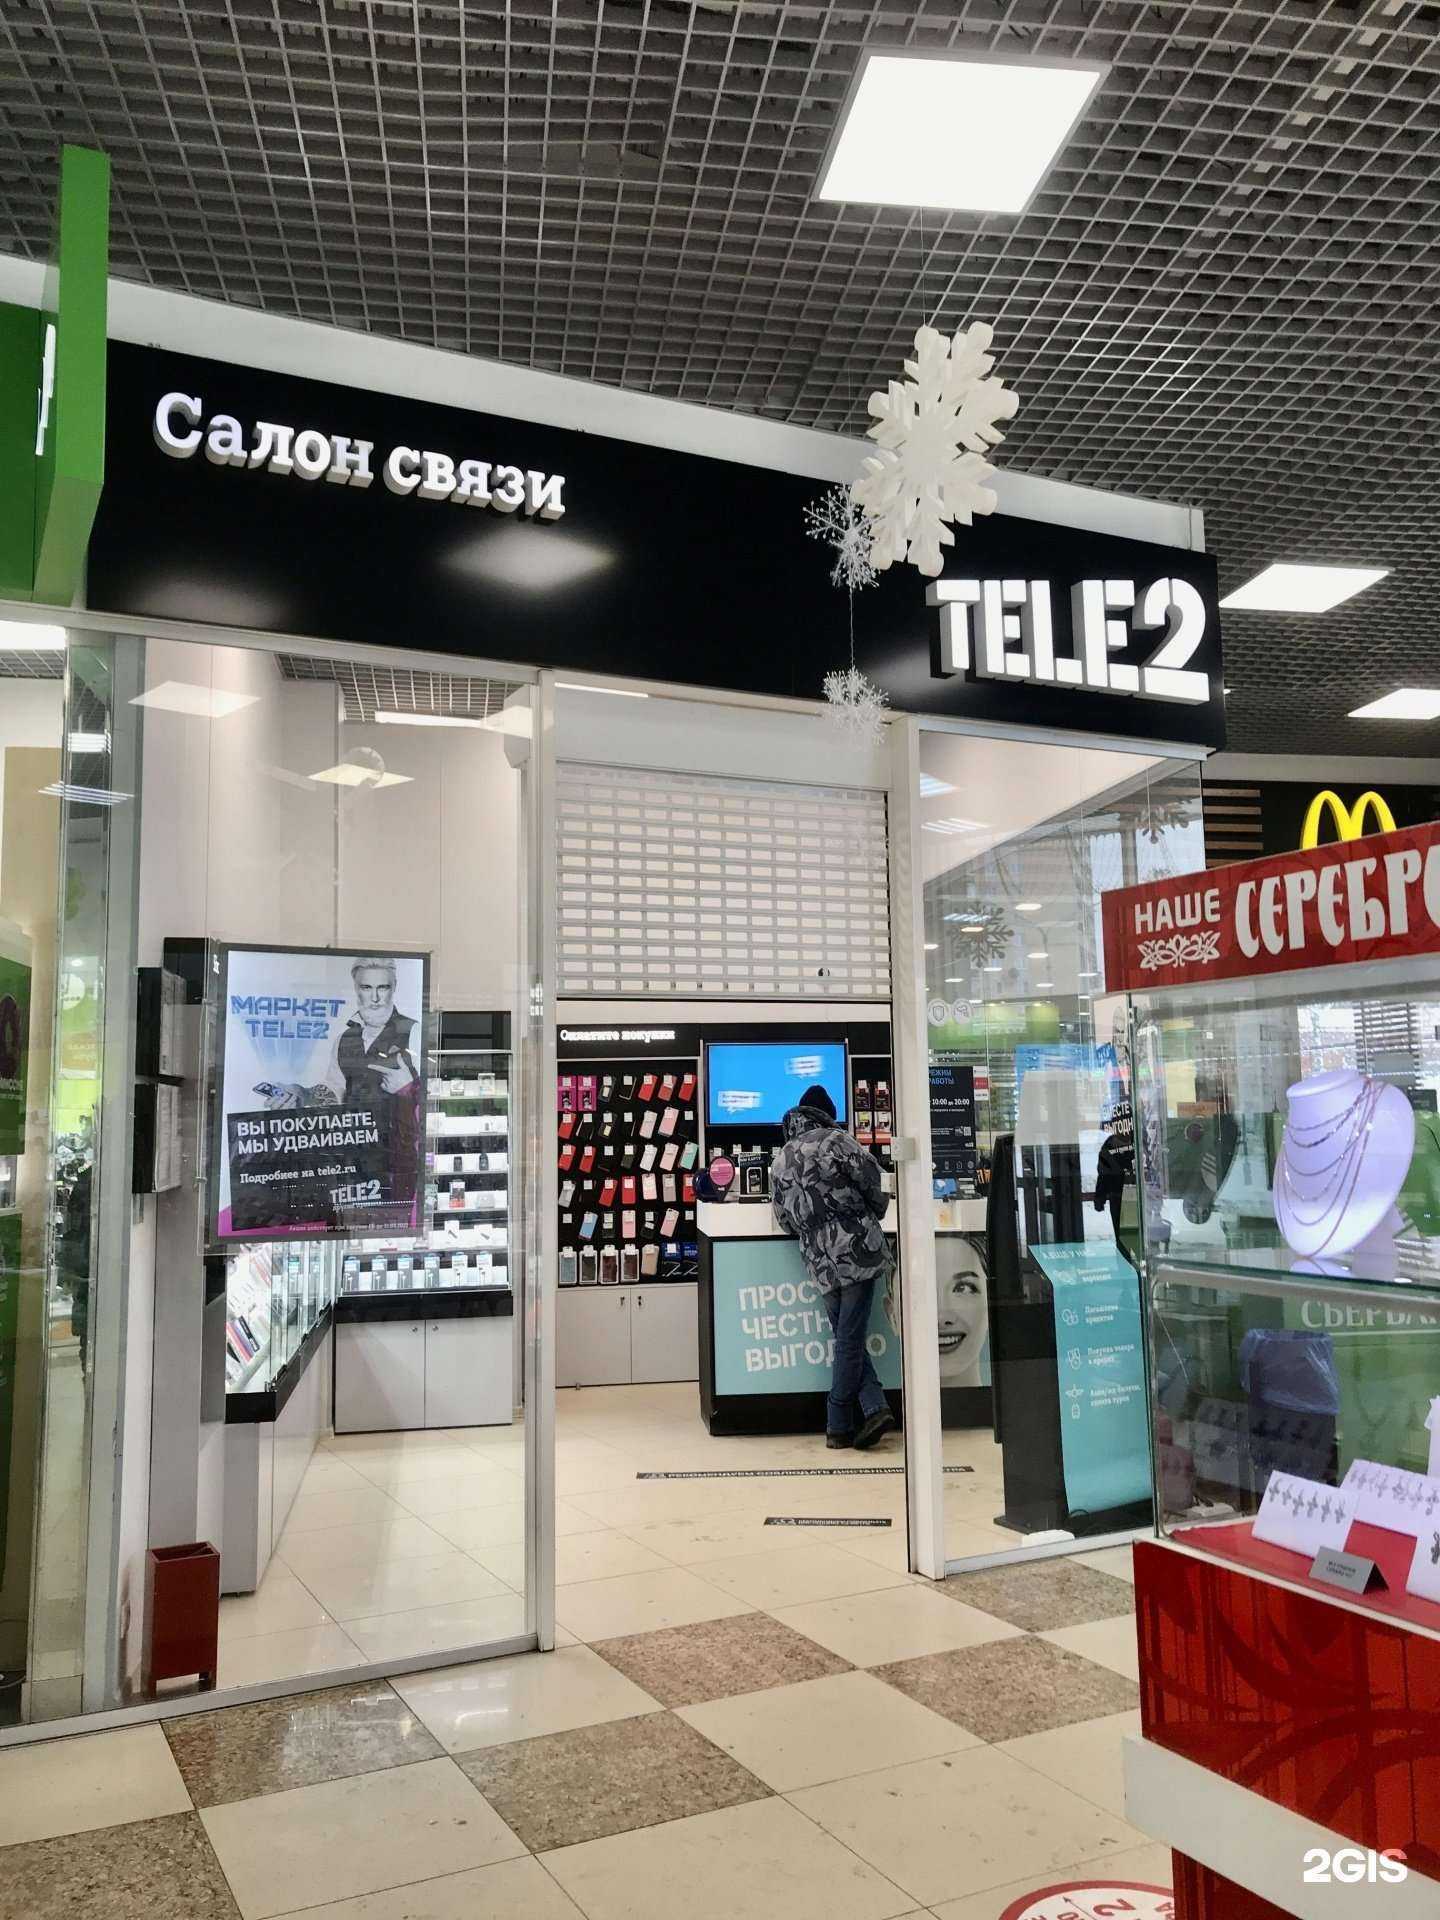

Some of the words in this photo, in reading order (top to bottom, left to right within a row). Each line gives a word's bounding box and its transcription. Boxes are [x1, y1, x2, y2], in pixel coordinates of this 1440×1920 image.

[154, 391, 373, 486] Салон
[384, 446, 566, 518] связи
[926, 577, 1210, 704] TELE2
[1134, 886, 1221, 934] НАШЕ
[230, 995, 347, 1018] МАРКЕТ
[245, 1020, 330, 1040] TELE2
[237, 1121, 265, 1137] ВЫ
[269, 1112, 377, 1134] ПОКУПАЕТЕ,
[238, 1139, 268, 1154] МЫ
[272, 1129, 379, 1154] УДВАИВАЕМ
[239, 1171, 299, 1185] Подробнее
[301, 1171, 315, 1179] на
[317, 1165, 357, 1176] tele2.ru
[329, 1179, 382, 1203] TELE2
[742, 1310, 833, 1340] ЧЕСТН
[745, 1333, 887, 1372] ВЫГОДО
